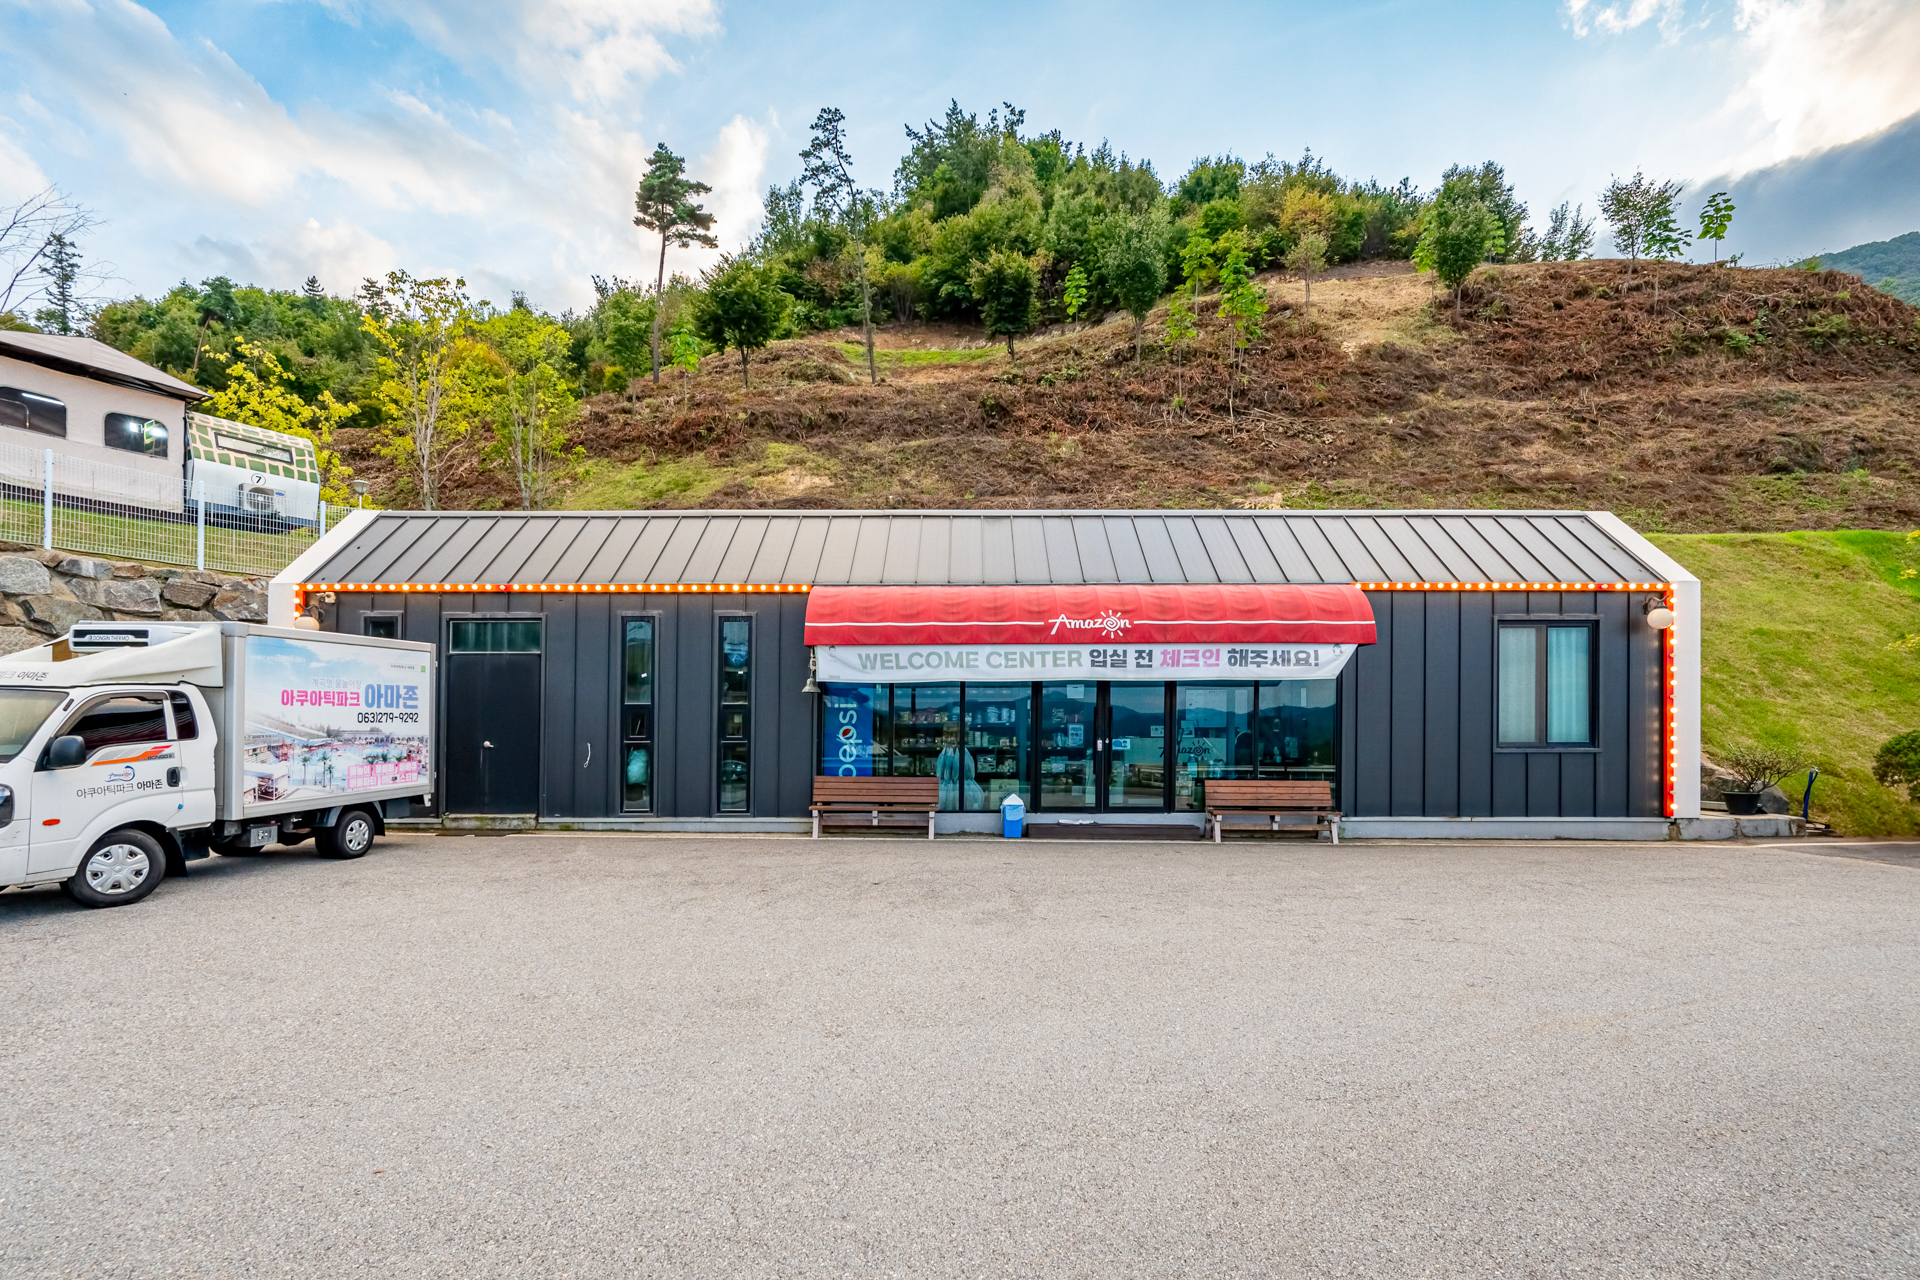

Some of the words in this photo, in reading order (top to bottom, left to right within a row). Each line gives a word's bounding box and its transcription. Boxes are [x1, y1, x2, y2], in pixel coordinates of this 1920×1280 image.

[1048, 610, 1132, 639] Amazon
[857, 651, 979, 671] WELCOME
[985, 650, 1083, 670] CENTER
[1089, 648, 1127, 669] 입실
[1134, 648, 1153, 669] 전
[1159, 648, 1221, 669] 체크인
[1227, 648, 1320, 668] 해주세요!
[17, 671, 49, 682] 아마존
[281, 689, 361, 707] 아쿠아틱파크
[364, 683, 419, 710] 아마존
[357, 711, 419, 724] 063)279-9292
[76, 783, 135, 799] 아쿠아틱파크
[136, 779, 164, 791] 아마존
